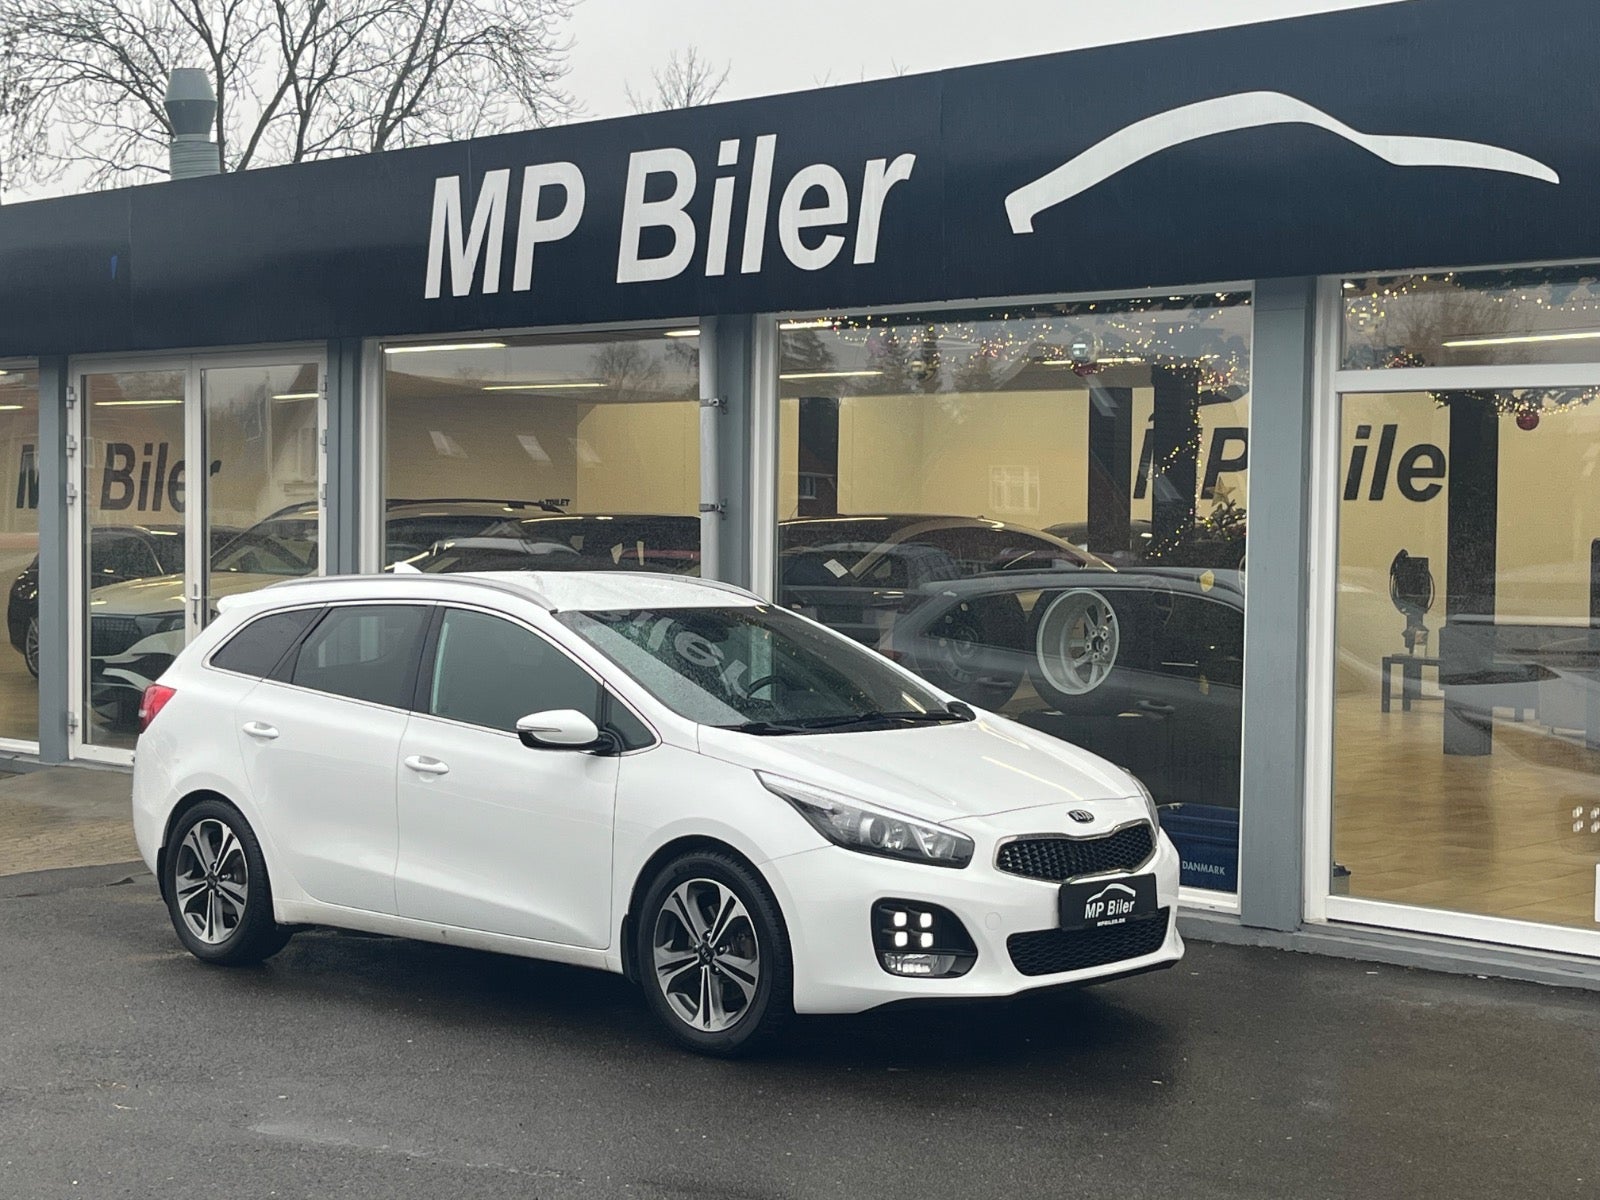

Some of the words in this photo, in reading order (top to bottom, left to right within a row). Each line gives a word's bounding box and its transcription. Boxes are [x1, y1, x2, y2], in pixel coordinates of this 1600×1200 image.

[424, 161, 586, 299] MP
[616, 134, 916, 284] Biler
[1342, 424, 1447, 503] ile
[1182, 860, 1226, 876] DANMARK
[1084, 901, 1105, 919] MP
[1106, 898, 1135, 916] Biler
